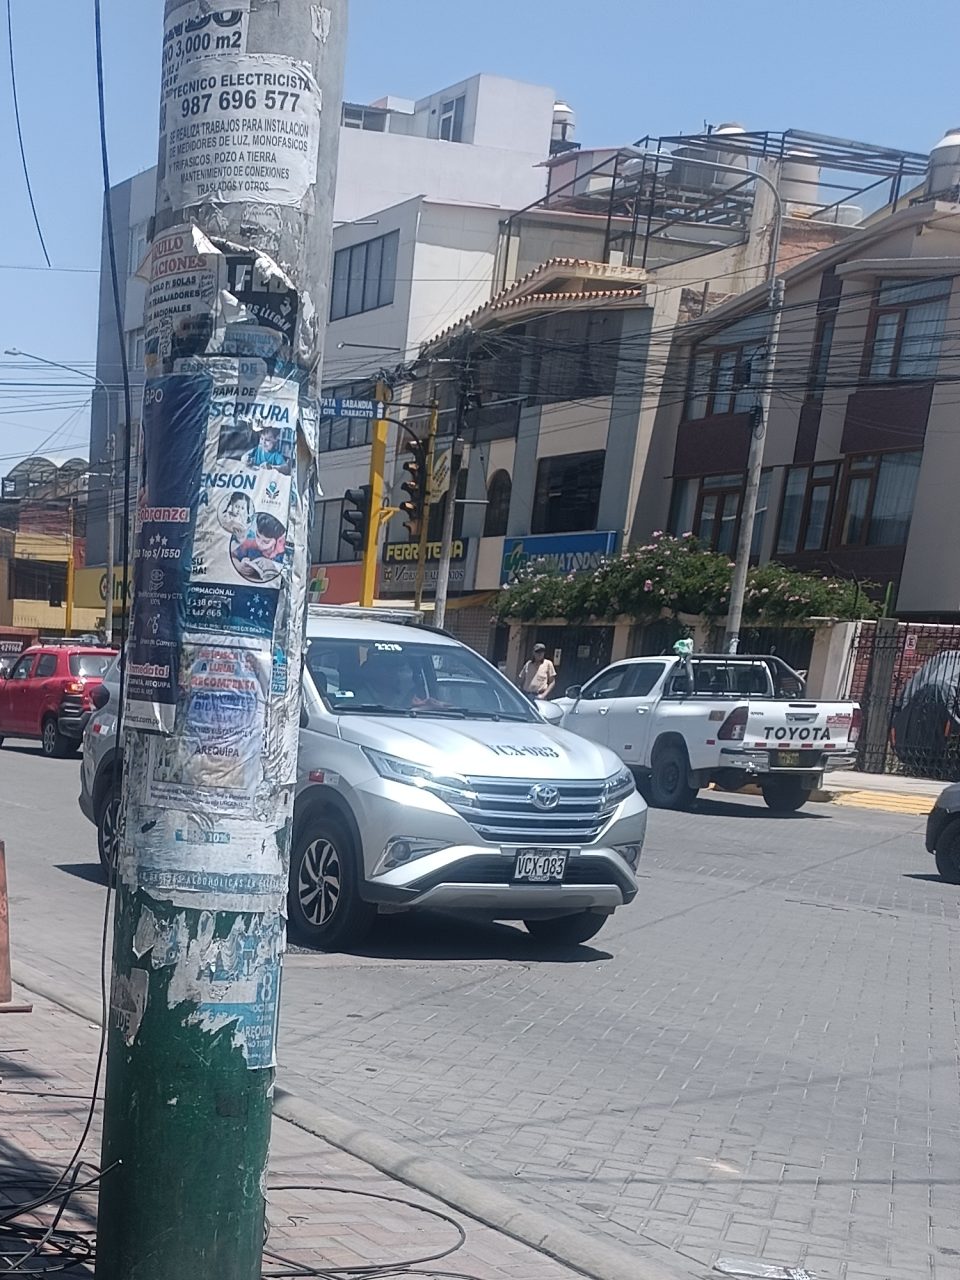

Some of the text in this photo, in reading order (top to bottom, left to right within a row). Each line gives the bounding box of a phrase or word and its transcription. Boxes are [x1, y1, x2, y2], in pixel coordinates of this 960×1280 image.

[176, 33, 210, 58] 3,000
[215, 31, 242, 49] m2
[173, 76, 216, 99] TECNICO
[220, 73, 311, 91] ELECTRICISTA
[182, 93, 212, 118] 987
[218, 89, 256, 110] 696
[264, 90, 301, 112] 577
[176, 125, 200, 141] REALIZA
[200, 118, 240, 136] TRABAJOS
[242, 118, 263, 132] PARA
[176, 136, 217, 156] MEDIDORES
[219, 135, 230, 147] DE
[252, 135, 308, 152] MONOFASICOS
[214, 151, 237, 164] POZO
[239, 152, 245, 163] A
[247, 151, 276, 164] TIERRA
[180, 166, 290, 183] MANTENIMIENTO DE CONEXIONES
[197, 181, 269, 196] TRASLADOS Y OTROS
[172, 275, 196, 288] SOLAS
[152, 289, 200, 305] TRABAJADORES
[153, 304, 192, 319] NACIONALES
[241, 363, 258, 374] DE
[241, 387, 258, 397] DE:
[341, 399, 373, 409] SABANDIA
[386, 540, 463, 561] FERRTEIA
[191, 676, 256, 690] RECOMPENSA
[764, 726, 831, 740] TOYOTA
[194, 745, 240, 757] AREQUIPA
[485, 744, 560, 758] VCX-083
[517, 856, 565, 876] VCX-083
